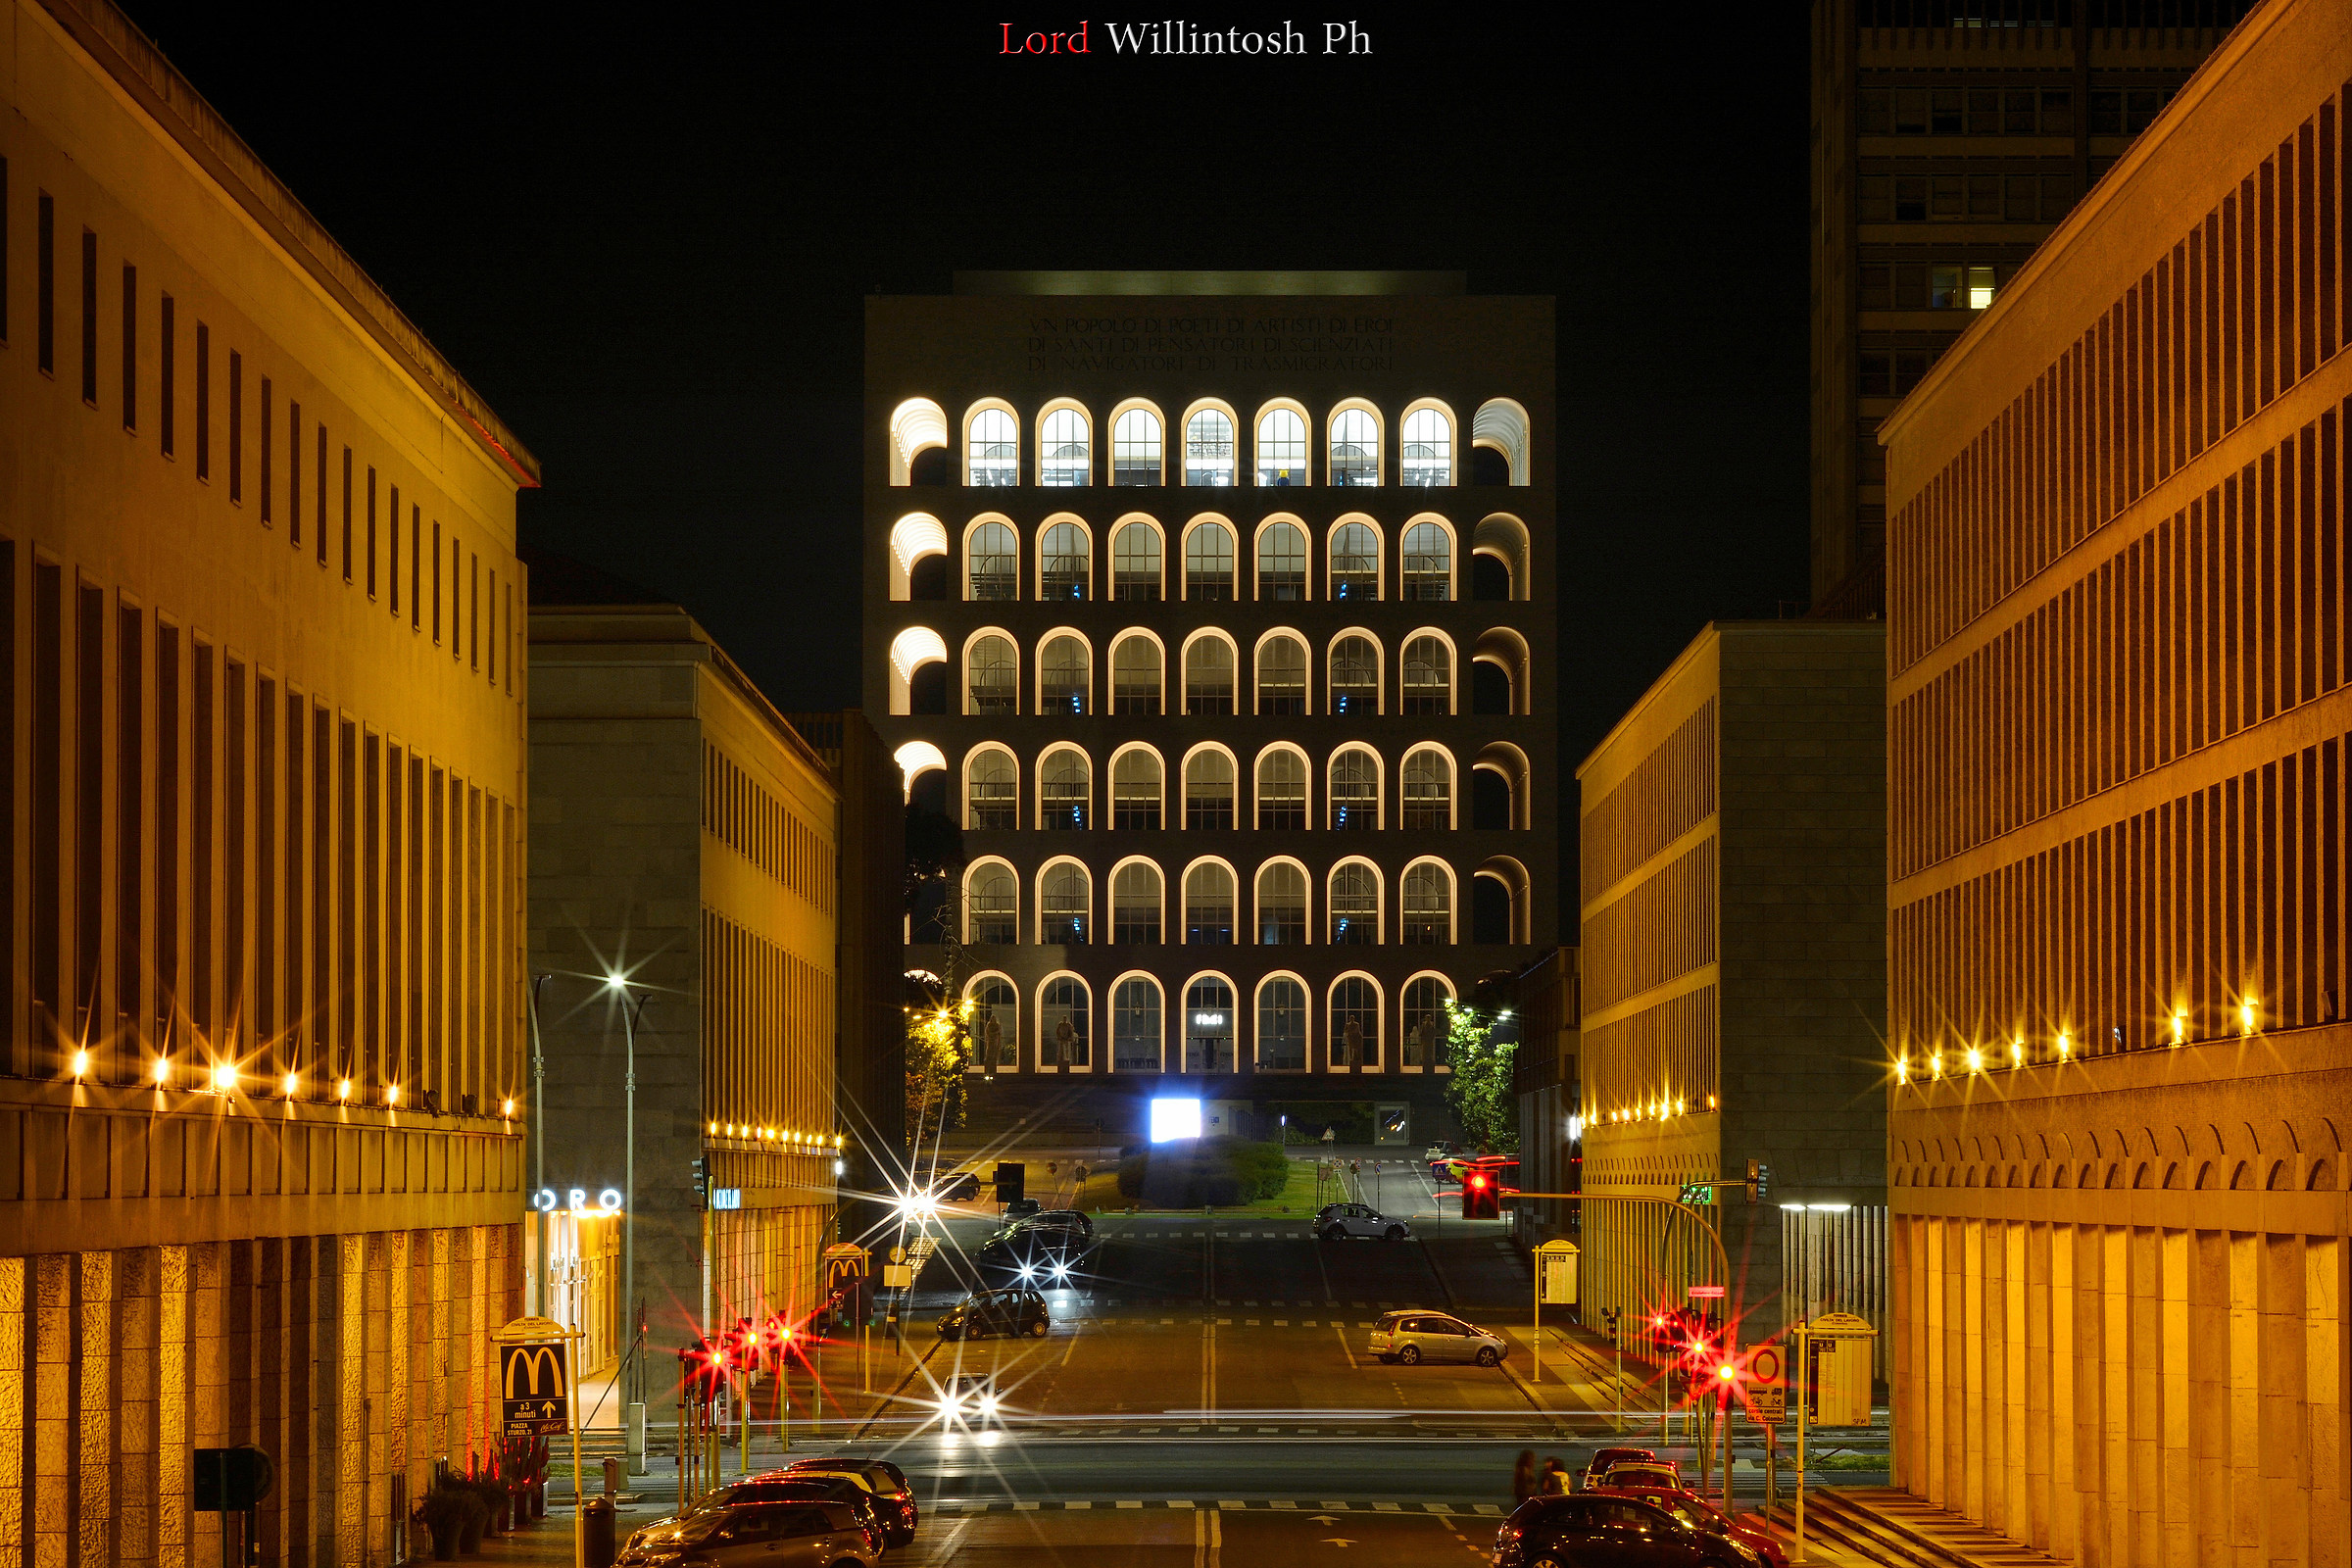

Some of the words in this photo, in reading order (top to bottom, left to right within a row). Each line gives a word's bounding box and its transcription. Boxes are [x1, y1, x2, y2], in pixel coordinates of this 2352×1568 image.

[1065, 318, 1137, 333] POPOLO
[1145, 318, 1161, 333] DI
[1169, 318, 1219, 333] POETI
[1227, 318, 1245, 333] DI
[1253, 318, 1321, 333] ARTISTI
[1329, 318, 1347, 333] DI
[1353, 318, 1393, 333] EROI
[1028, 337, 1046, 353] DI
[1054, 337, 1112, 353] SANTI
[1122, 337, 1139, 353] DI
[1148, 337, 1254, 353] PENSATORI
[1263, 337, 1281, 353] DI
[1290, 337, 1393, 353] SCIENZIATI
[1028, 356, 1046, 371] DI
[1061, 356, 1184, 371] NAVIGATORI
[1199, 356, 1215, 371] DI
[1231, 356, 1393, 371] TRASMIGRATORI
[514, 1409, 537, 1419] minuti
